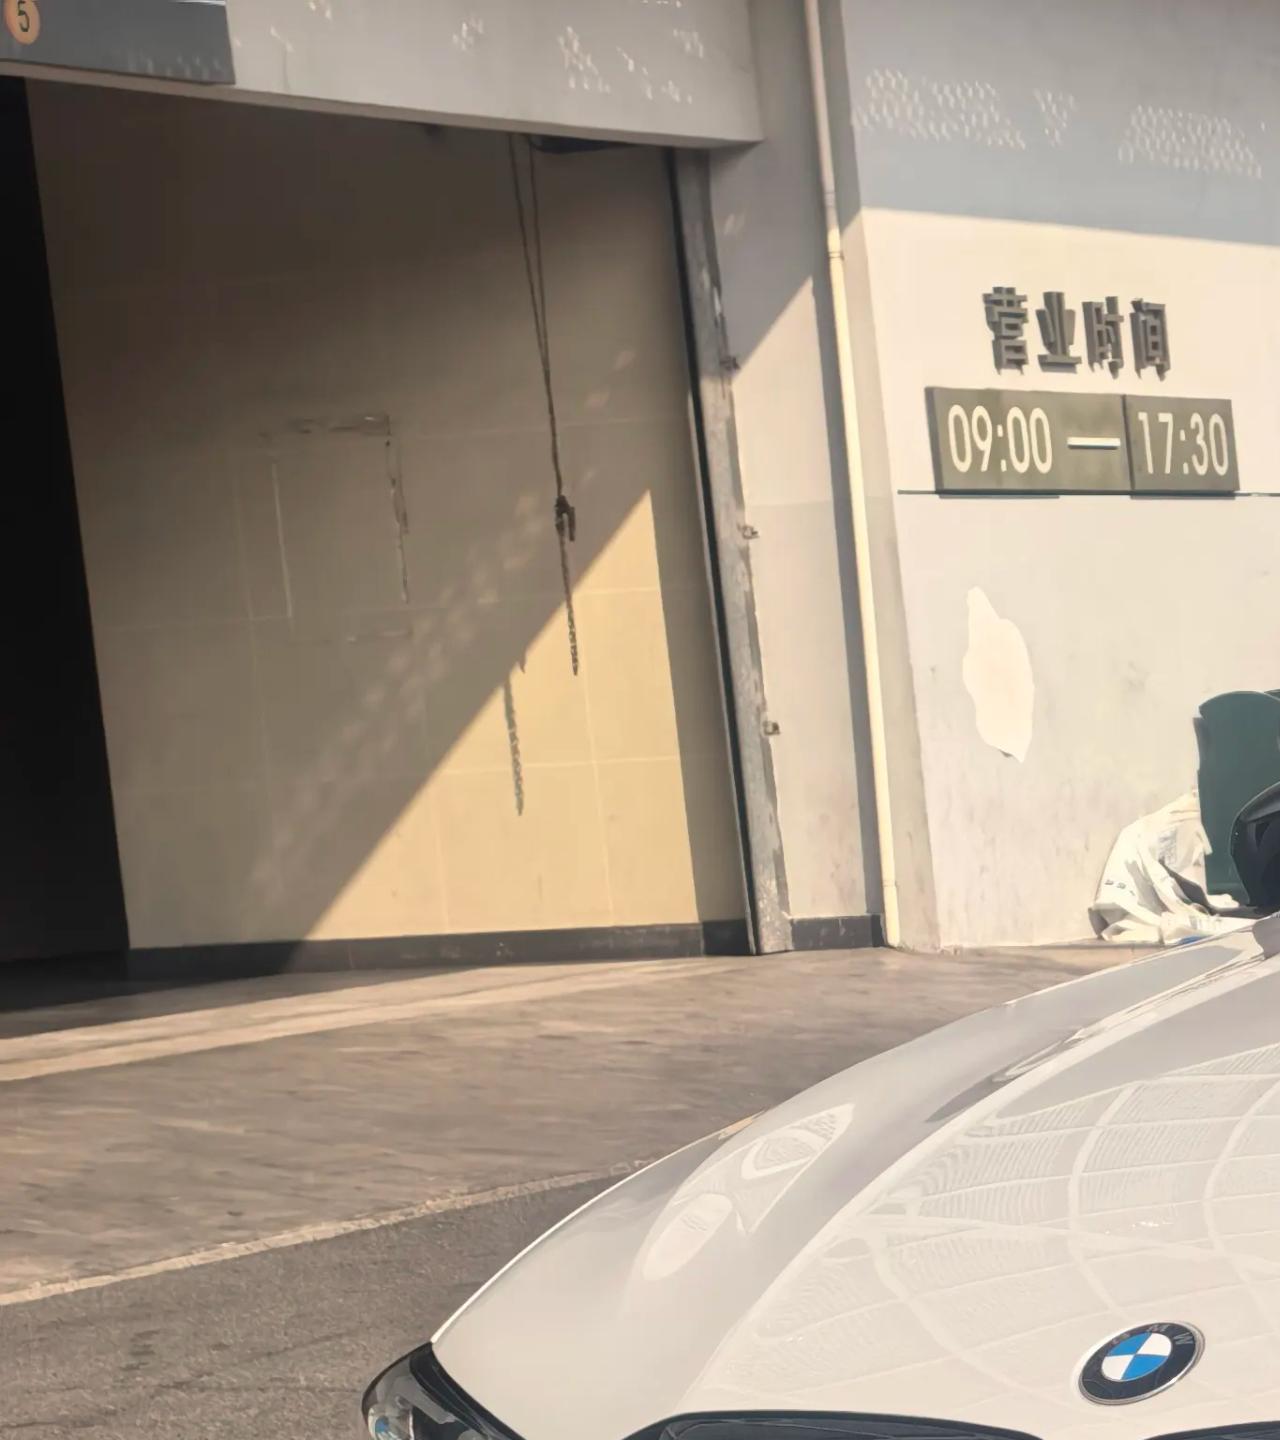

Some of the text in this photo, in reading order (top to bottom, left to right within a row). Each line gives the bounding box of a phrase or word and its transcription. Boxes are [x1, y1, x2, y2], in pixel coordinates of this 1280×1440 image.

[982, 286, 1170, 381] 营业时间
[949, 404, 1052, 474] 09:00
[1138, 411, 1229, 476] 17:30
